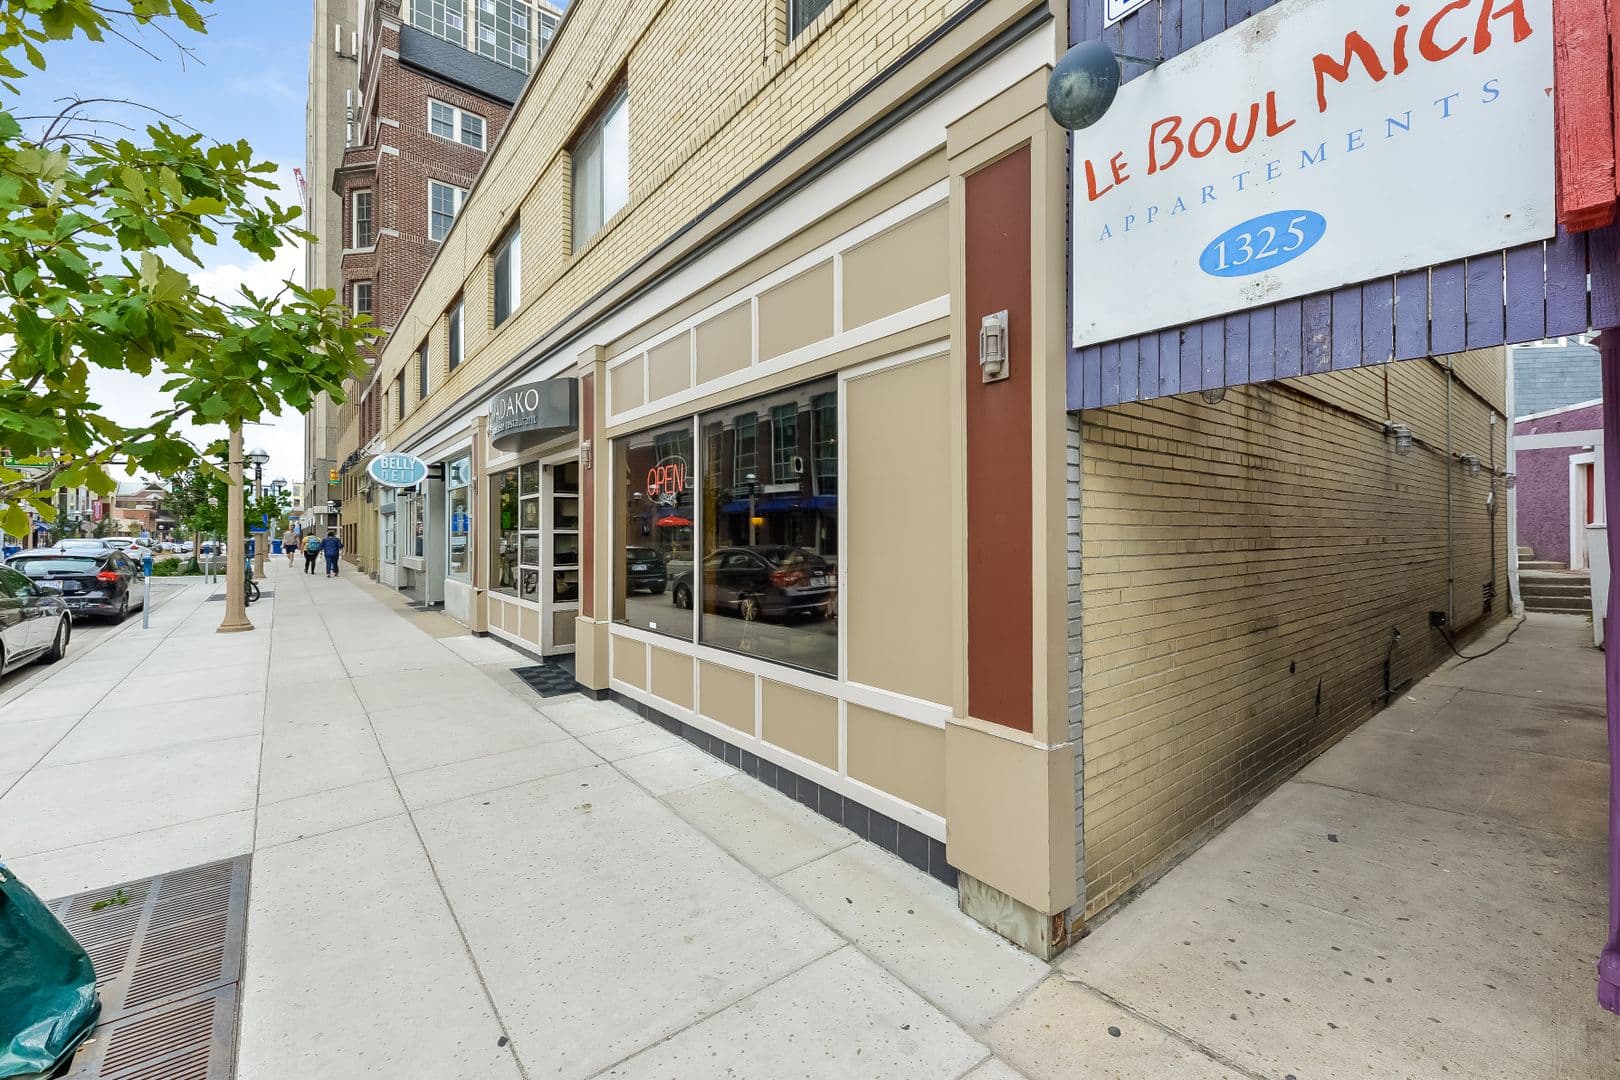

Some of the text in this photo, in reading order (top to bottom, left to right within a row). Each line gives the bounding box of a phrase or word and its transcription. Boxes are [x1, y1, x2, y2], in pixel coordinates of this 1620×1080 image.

[1085, 151, 1130, 202] LE
[1147, 90, 1296, 175] BOUL
[1099, 79, 1501, 240] APPARTEMENTS
[1213, 215, 1307, 271] 1325
[493, 389, 539, 421] ADAKO
[381, 457, 416, 470] BELLY
[647, 463, 684, 496] OPEN
